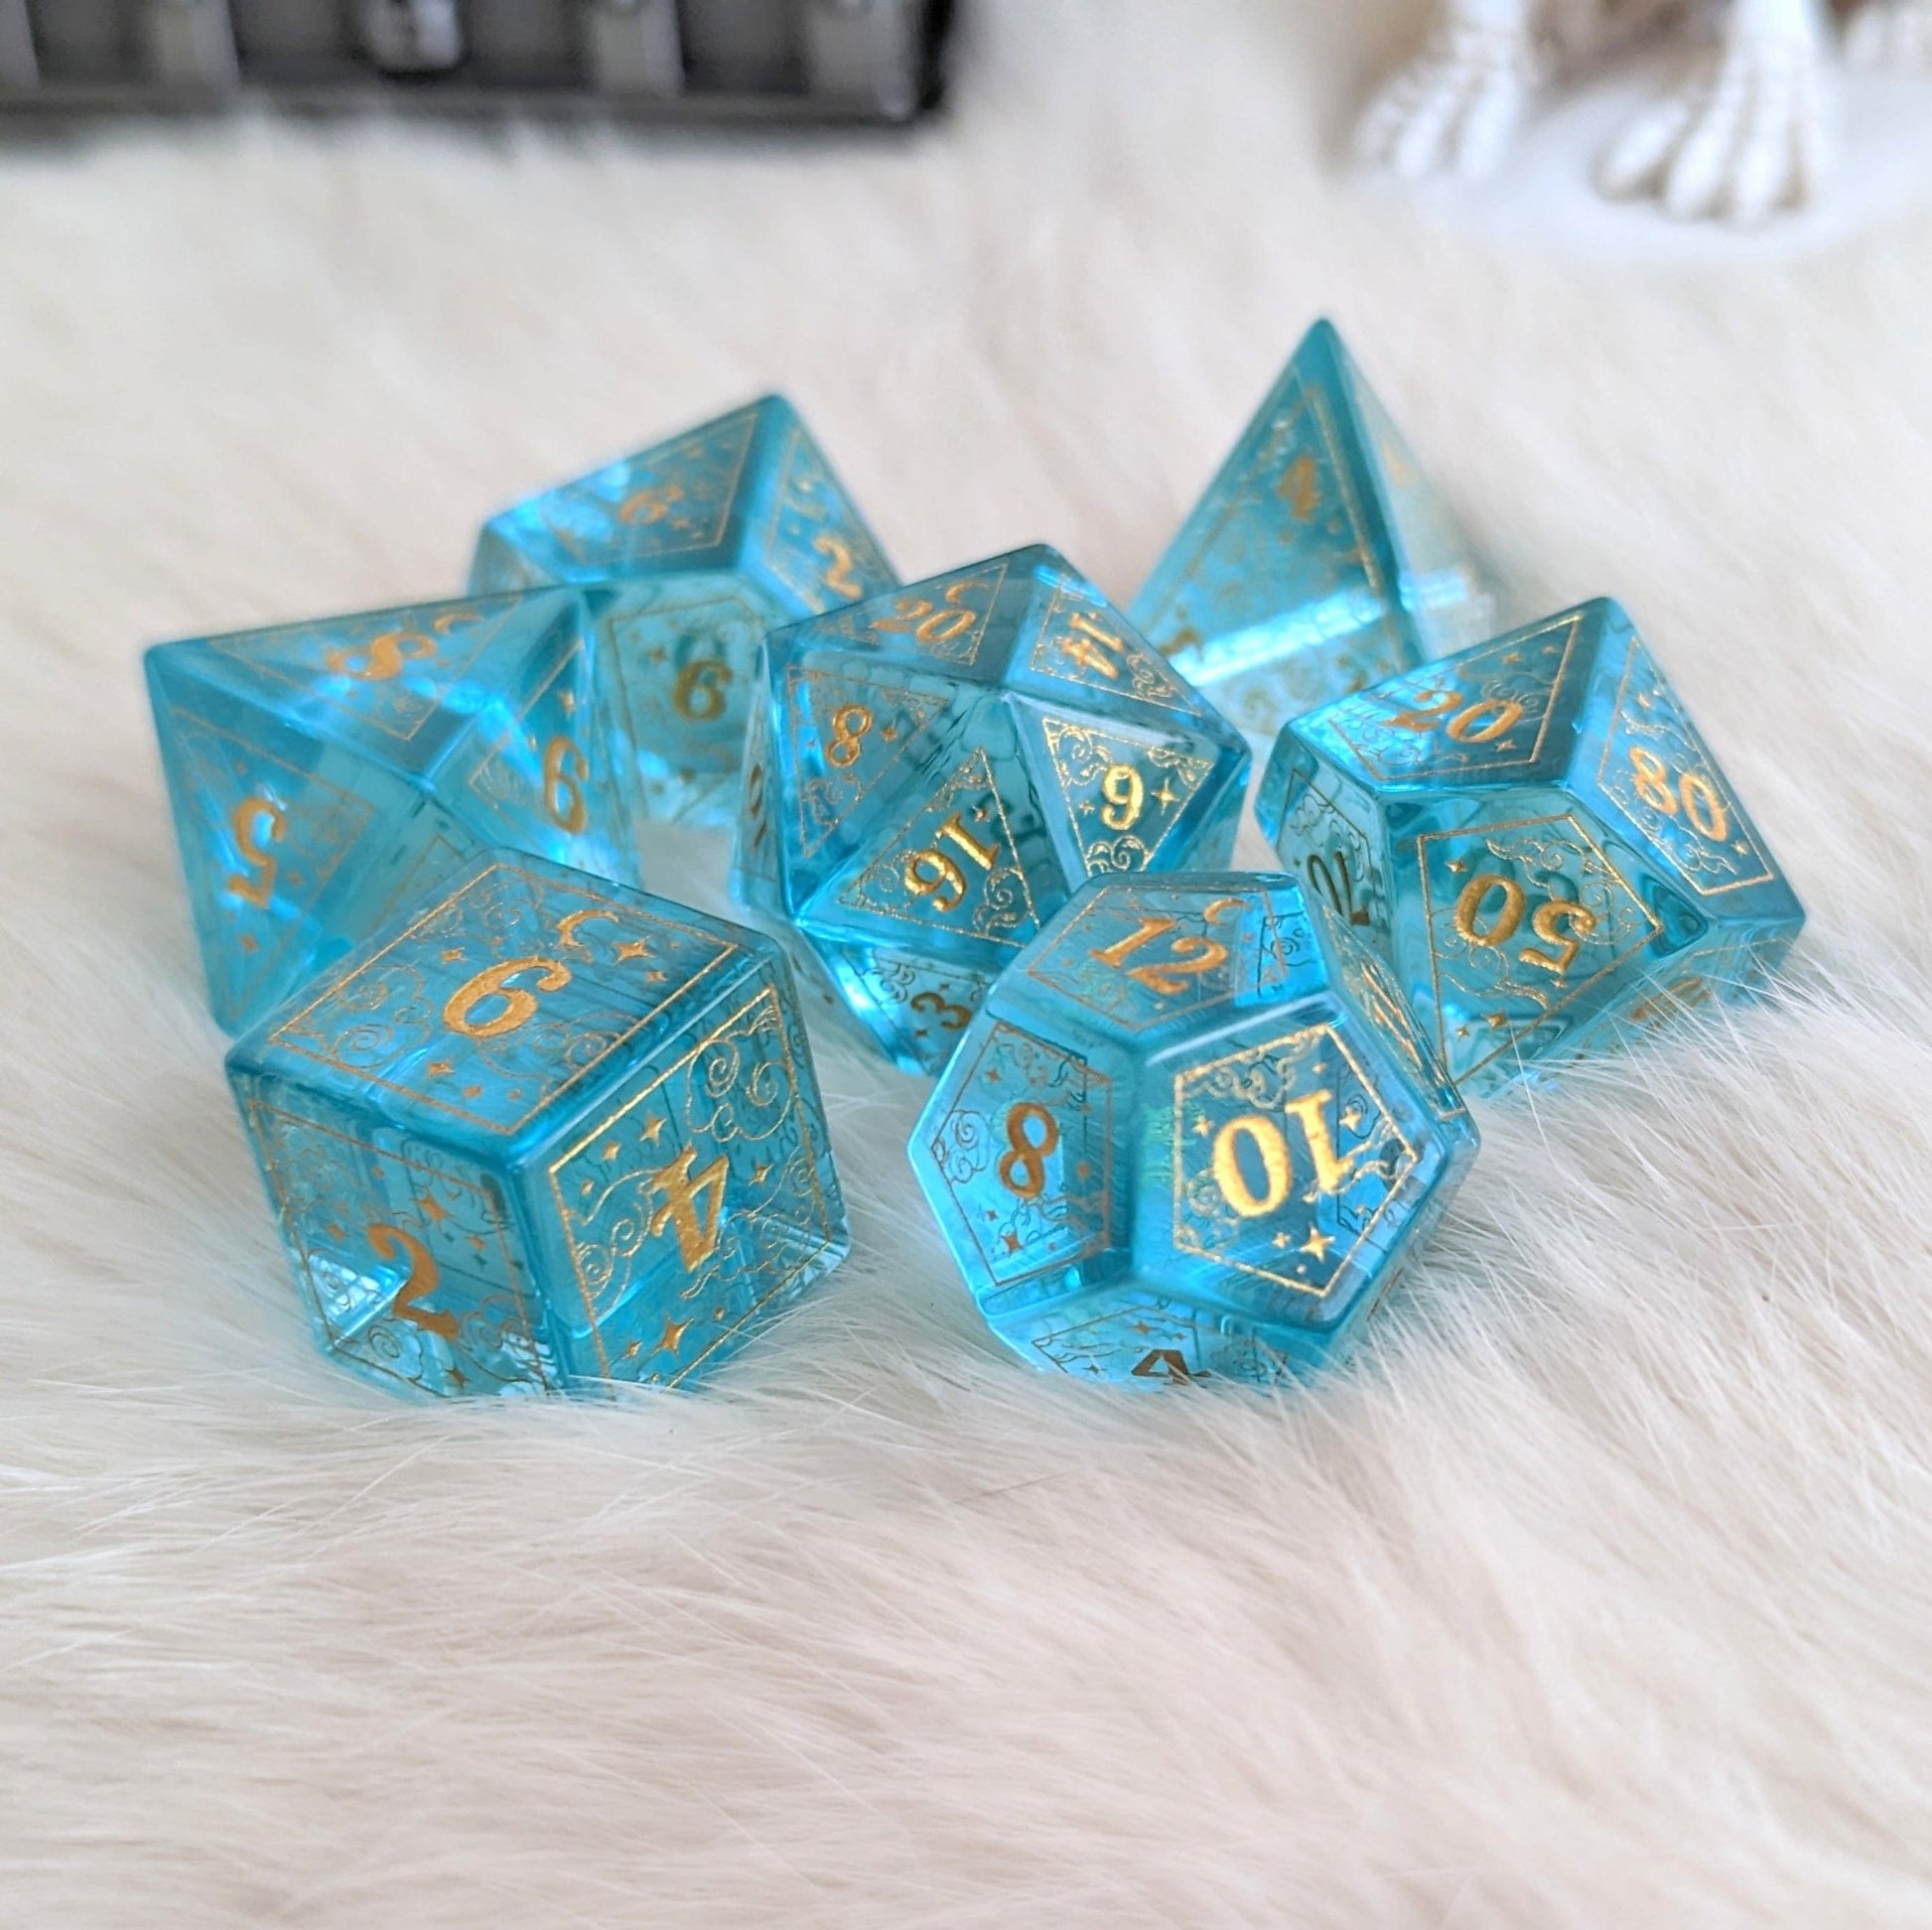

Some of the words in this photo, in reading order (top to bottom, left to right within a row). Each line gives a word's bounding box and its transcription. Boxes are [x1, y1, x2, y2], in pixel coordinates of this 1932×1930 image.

[813, 535, 863, 599] 2
[870, 599, 976, 643] 20
[825, 705, 873, 768] 8
[1382, 690, 1524, 743] 20
[1628, 747, 1728, 842] 80
[1092, 917, 1228, 994] 12
[1453, 874, 1596, 976] 50
[442, 956, 572, 1038] 6
[909, 992, 972, 1032] 3
[998, 1101, 1058, 1197] 8
[1212, 1089, 1353, 1218] 10
[650, 1143, 729, 1273] 4
[367, 1221, 459, 1342] 2
